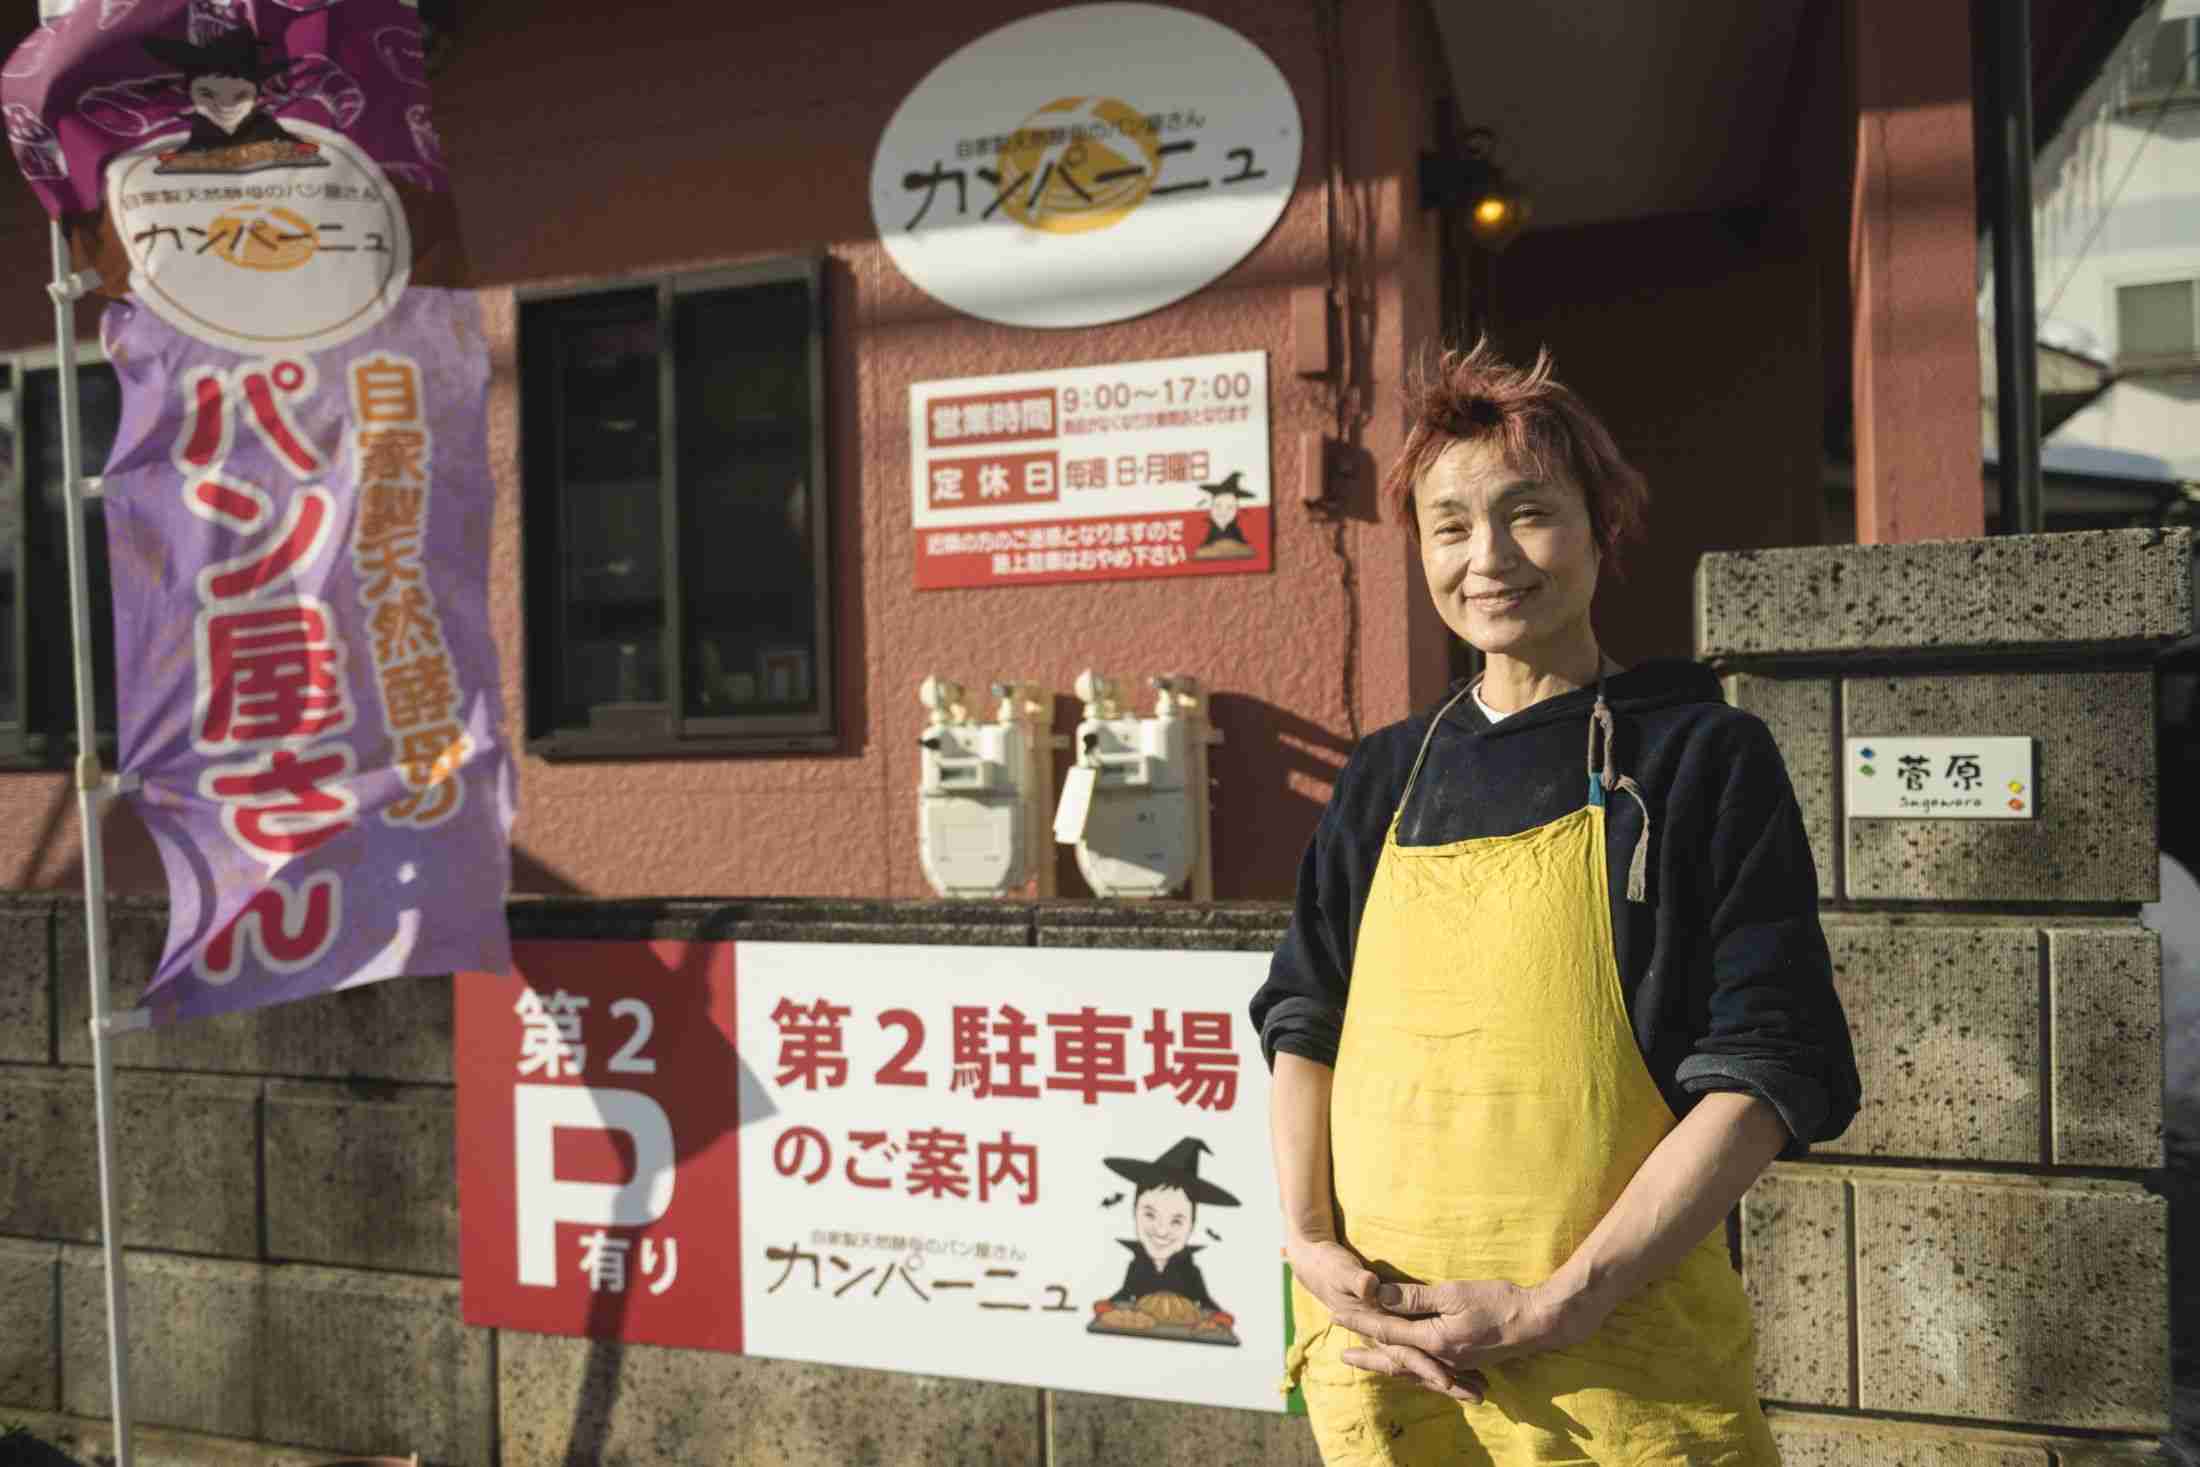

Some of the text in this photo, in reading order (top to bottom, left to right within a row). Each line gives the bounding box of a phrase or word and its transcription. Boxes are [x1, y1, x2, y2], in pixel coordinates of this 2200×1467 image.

[902, 139, 1268, 232] カンパーニュ
[134, 217, 390, 256] カンパーニュ
[931, 398, 1052, 439] 営業時間
[931, 460, 1054, 501] 定休日
[354, 354, 466, 824] 自家製天然酵母の
[181, 359, 353, 976] パン屋さん
[1897, 754, 1984, 792] 菅原
[513, 987, 656, 1078] 第2
[769, 996, 1242, 1113] 第2駐車場
[513, 1083, 676, 1287] P
[772, 1125, 1040, 1206] のご案内
[579, 1230, 680, 1296] 有り
[765, 1242, 1079, 1311] カンパーニュ
